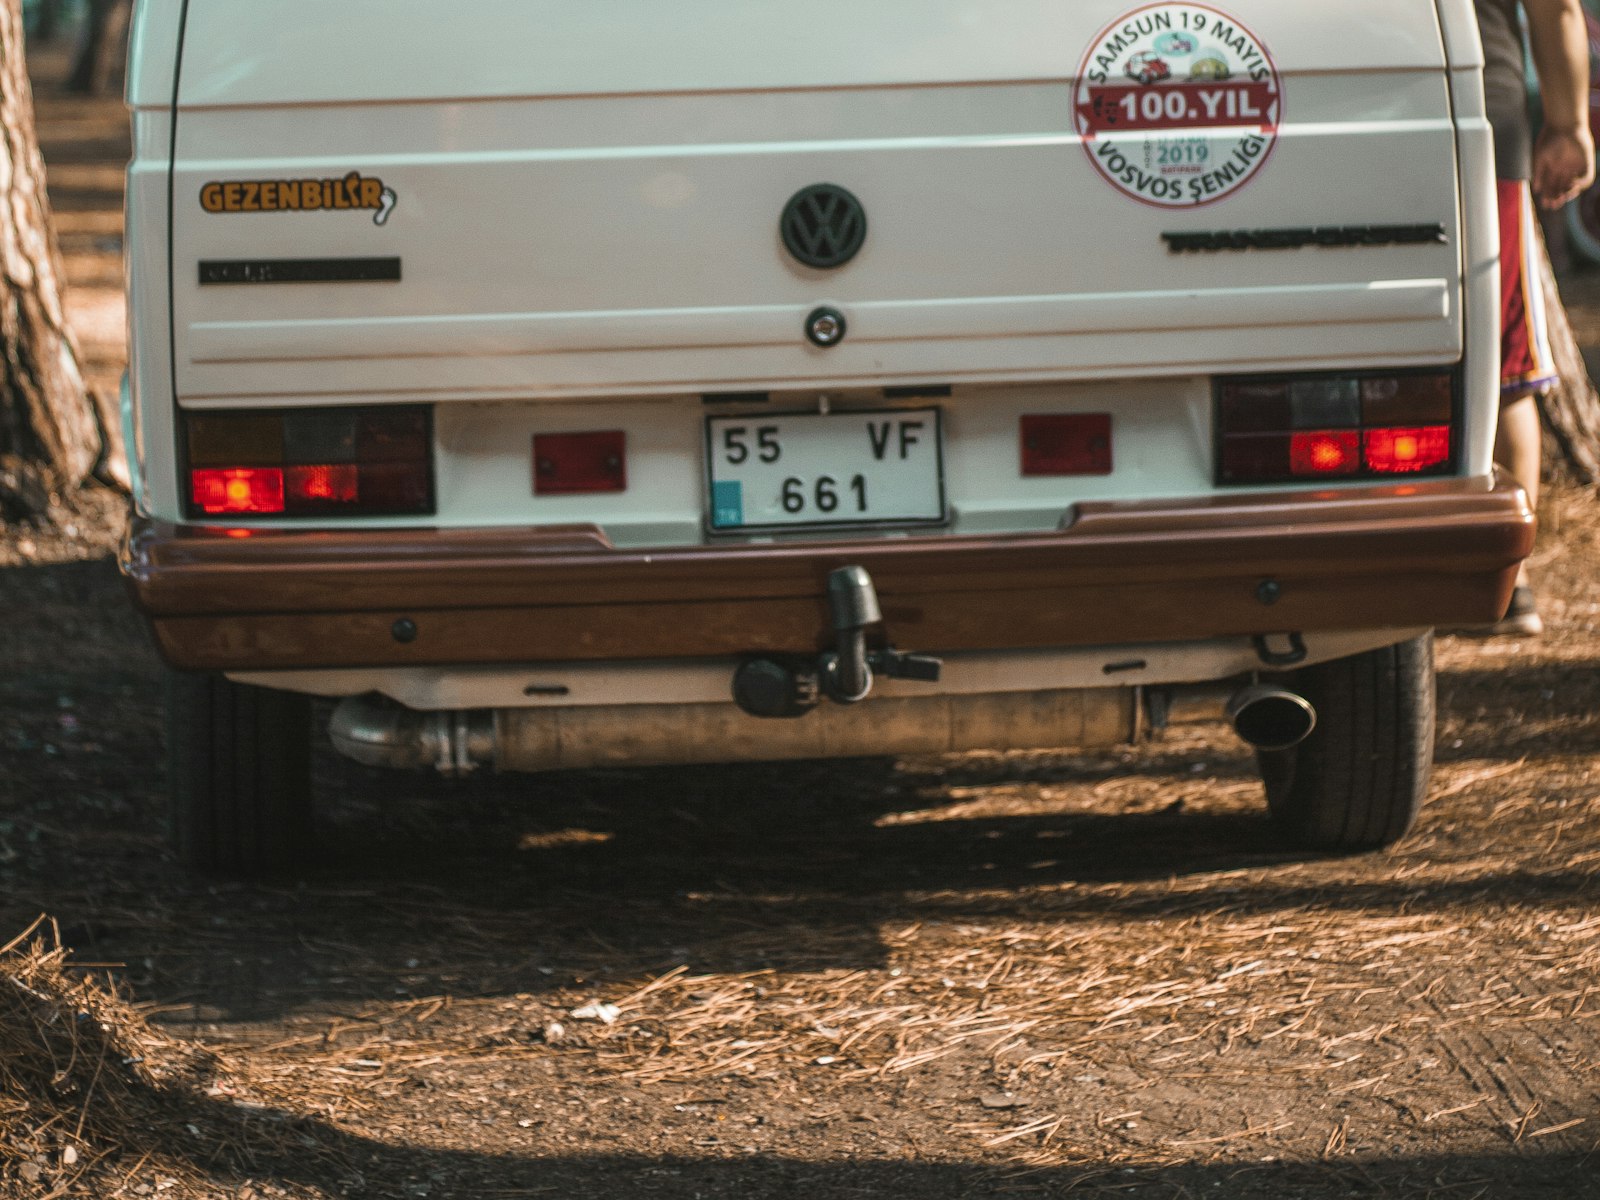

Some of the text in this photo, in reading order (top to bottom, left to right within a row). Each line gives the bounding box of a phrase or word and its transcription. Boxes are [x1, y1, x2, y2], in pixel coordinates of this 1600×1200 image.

[1088, 11, 1270, 85] SAMSUN 19 MAYIS
[1118, 90, 1261, 122] 100.YIL
[1096, 140, 1184, 201] VOSVOS
[1157, 144, 1209, 165] 2019
[723, 421, 923, 465] 55 VF
[781, 474, 867, 513] 661
